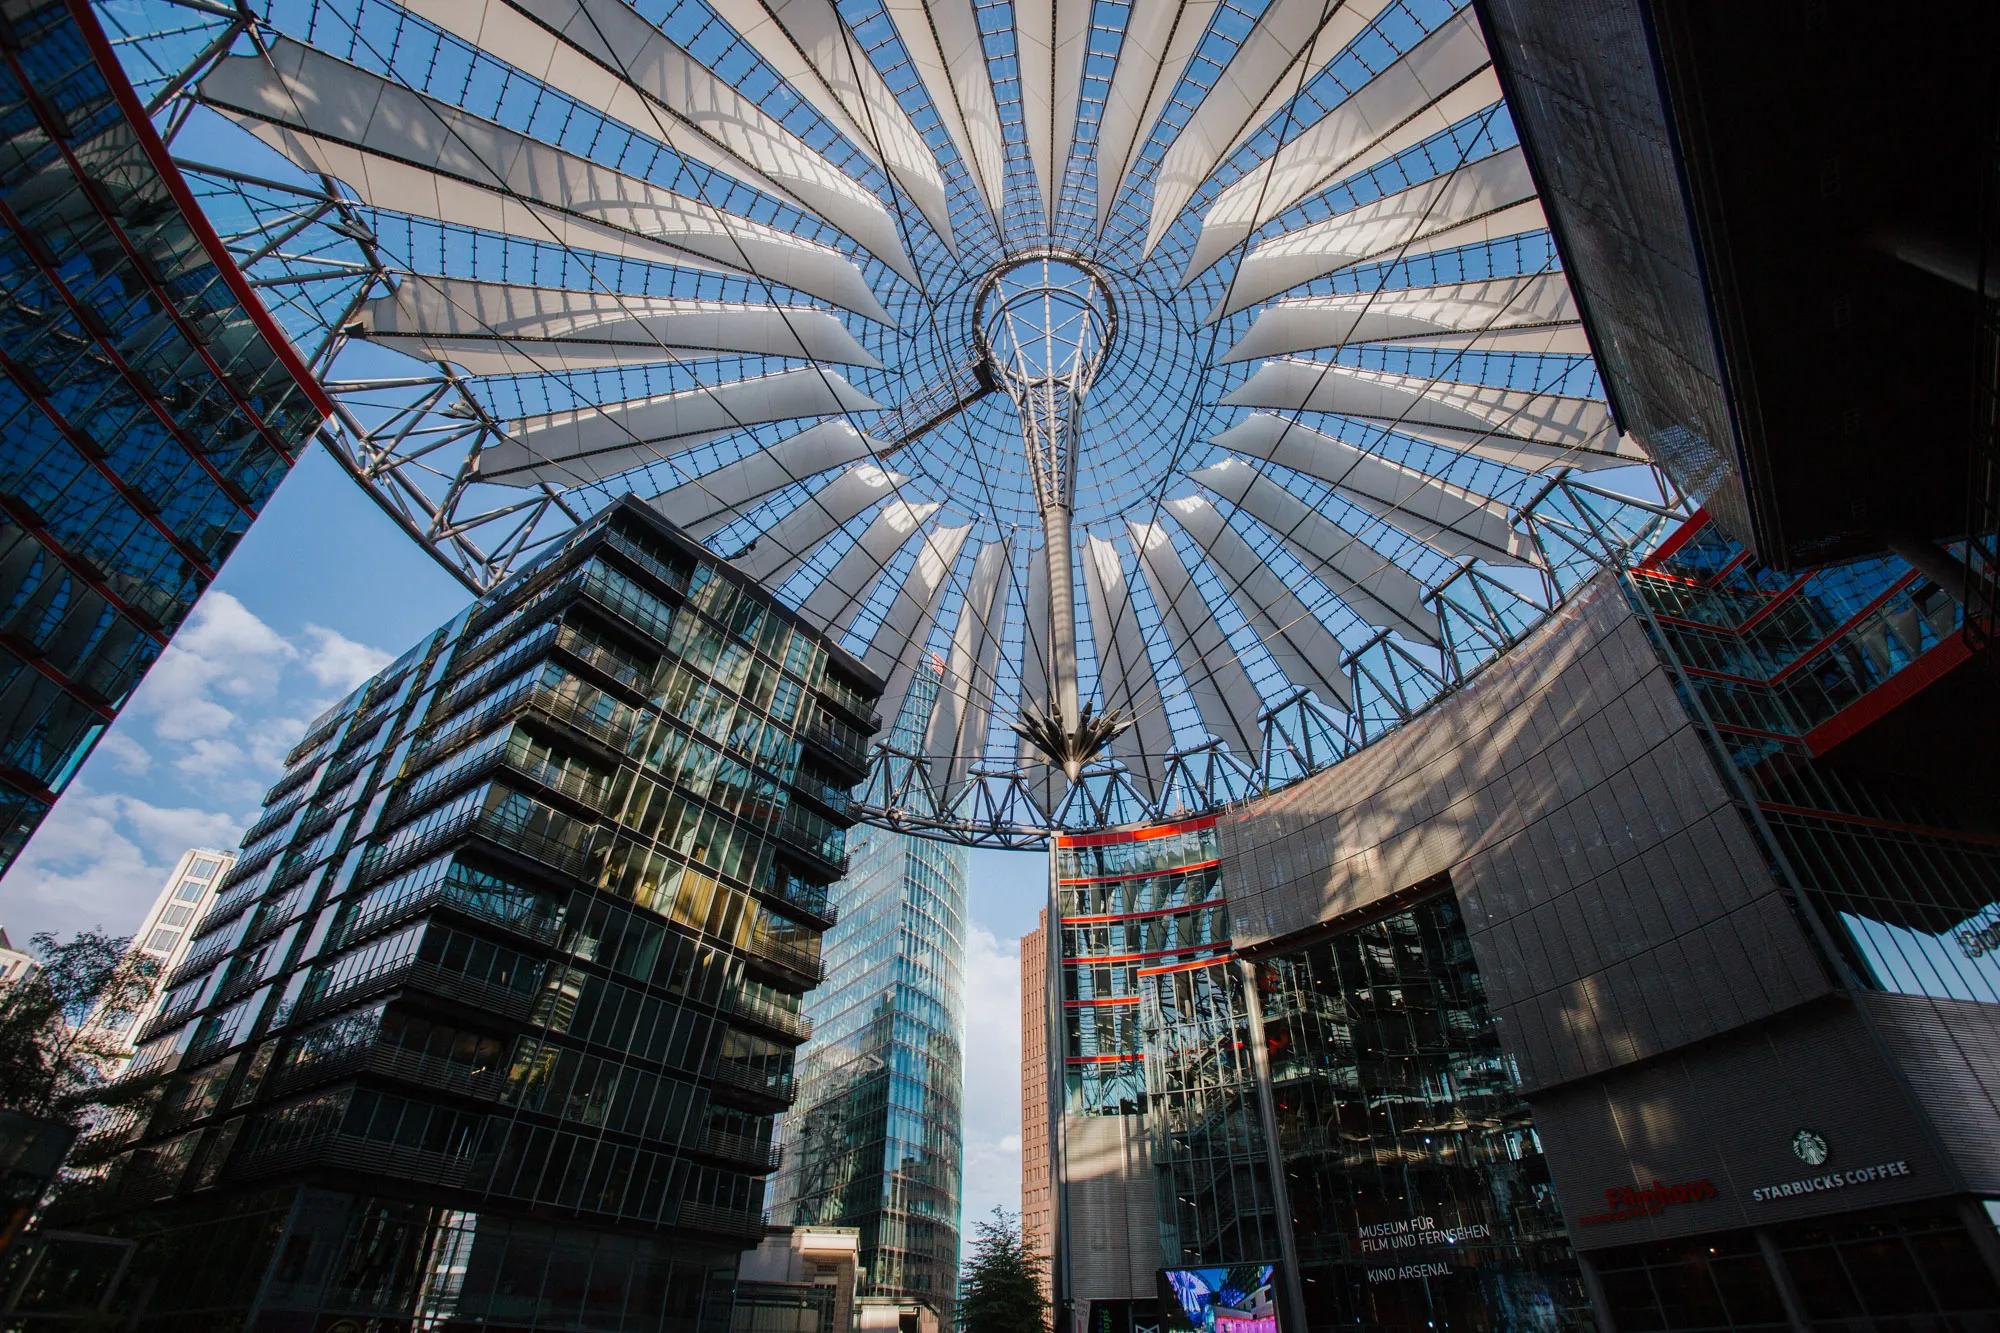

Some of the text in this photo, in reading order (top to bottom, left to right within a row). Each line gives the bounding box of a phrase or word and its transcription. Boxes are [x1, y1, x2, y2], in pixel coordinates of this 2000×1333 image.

[1753, 1161, 1910, 1201] STARBUCKS COFFEE
[1359, 1215, 1435, 1238] MUSEUM FÜR
[1361, 1224, 1490, 1252] FILM UND FERNSEHEN
[1367, 1262, 1453, 1283] KINO ARSENAL
